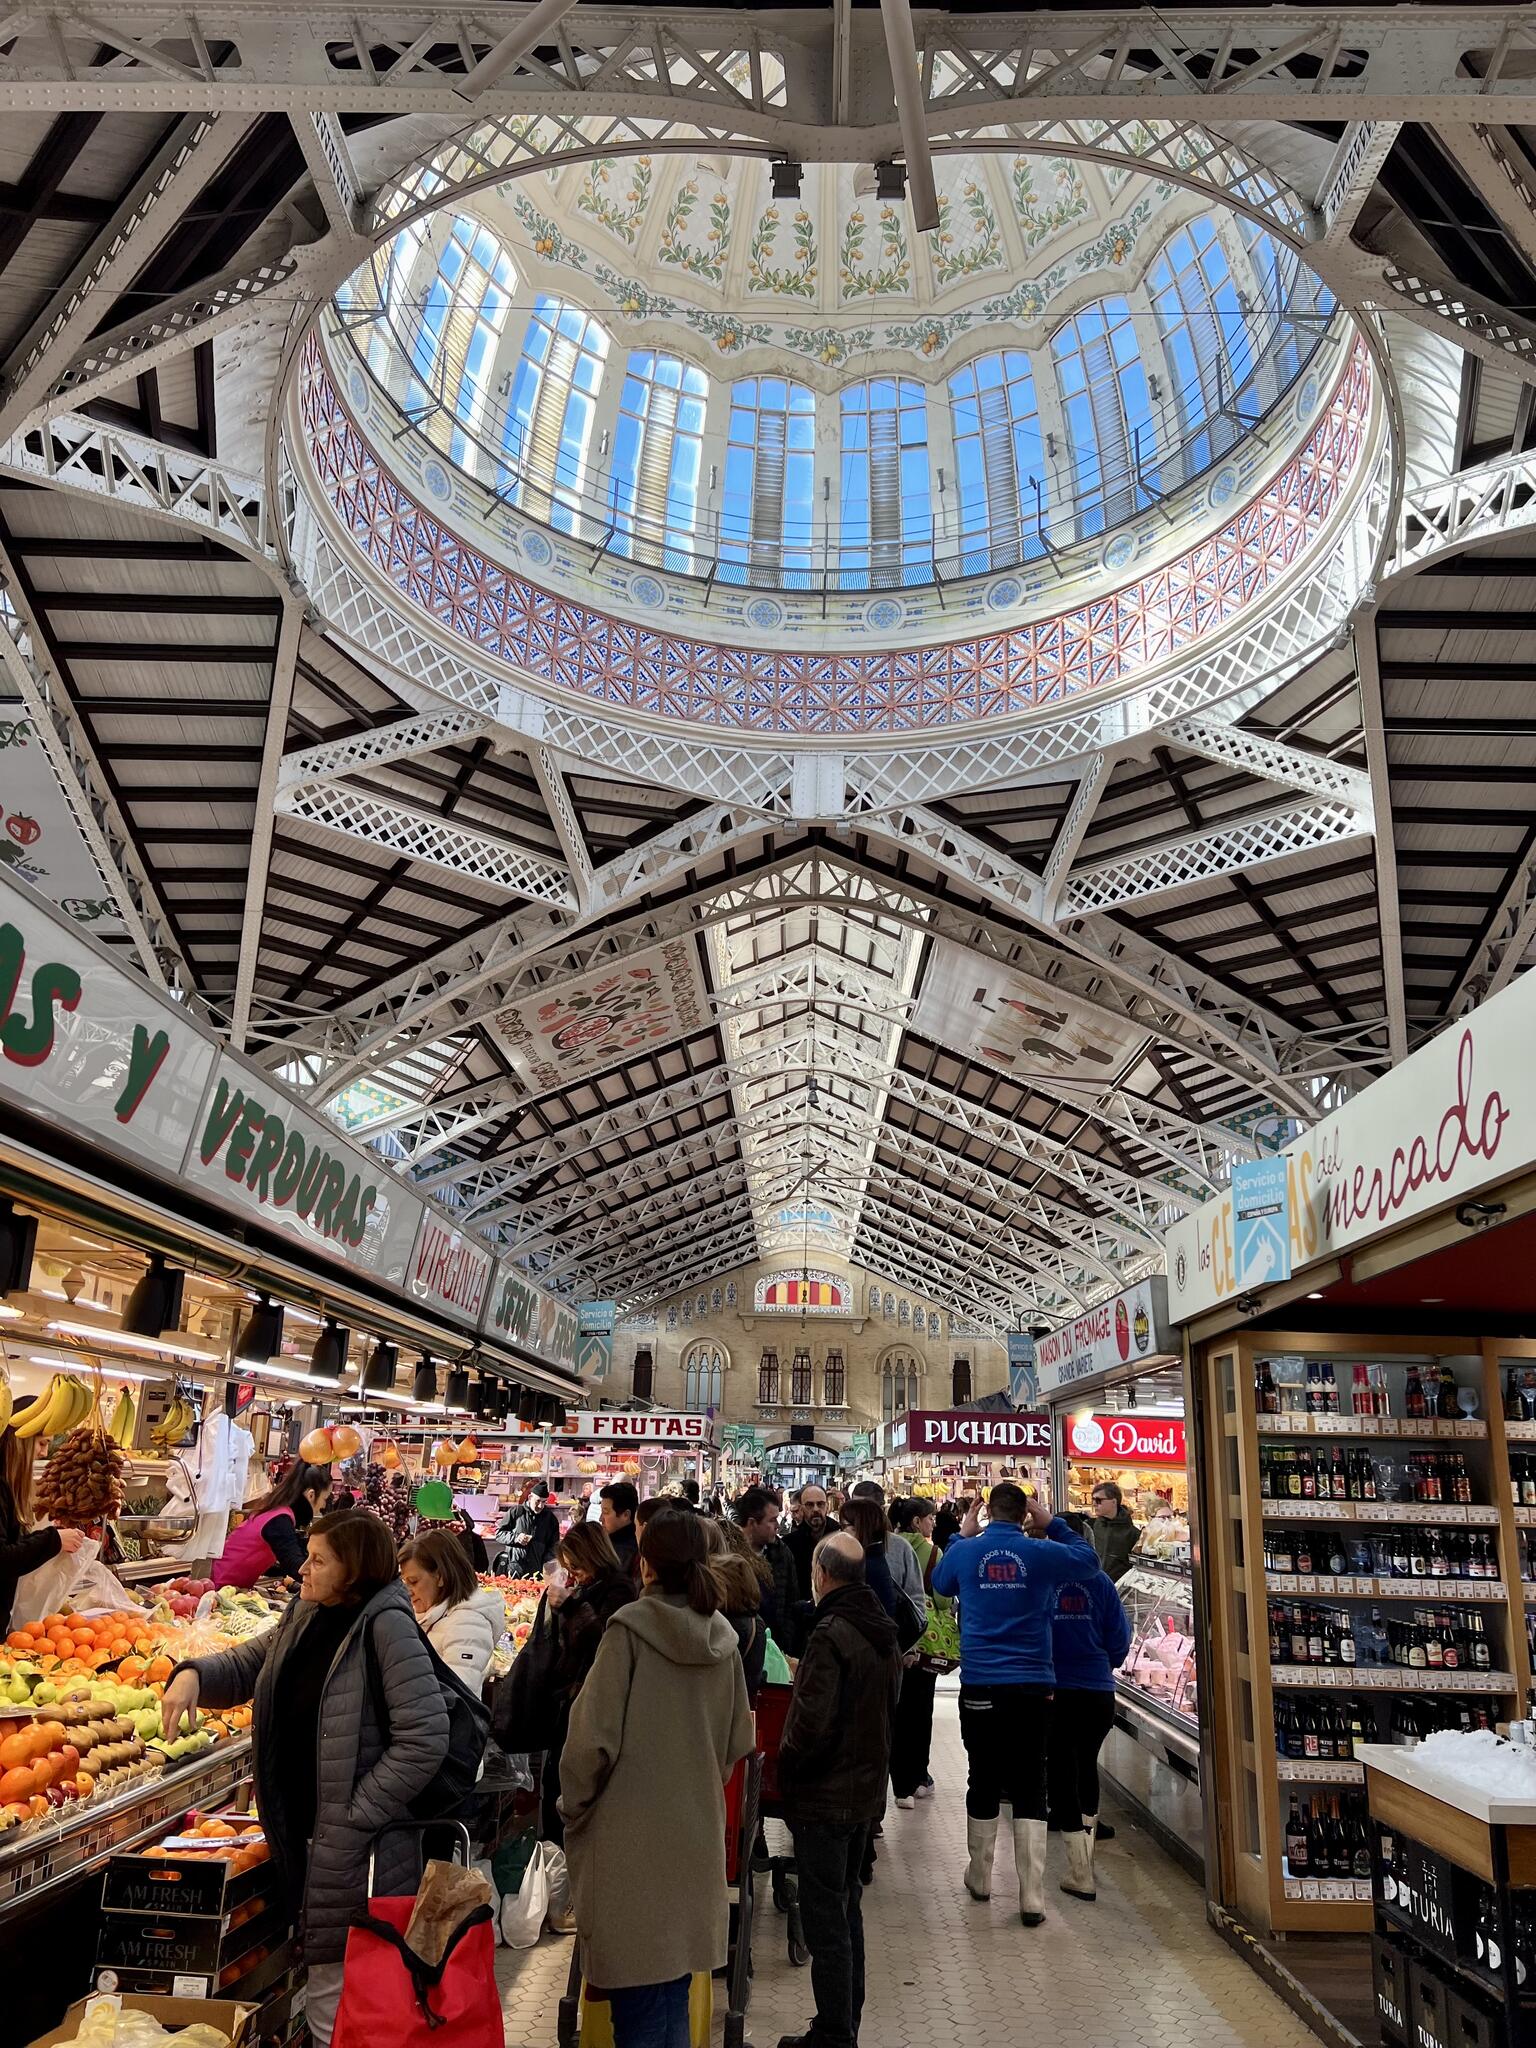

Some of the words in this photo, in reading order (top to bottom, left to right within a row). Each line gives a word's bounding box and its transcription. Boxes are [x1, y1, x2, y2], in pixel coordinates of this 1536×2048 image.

[114, 1023, 170, 1124] Y
[200, 1077, 377, 1248] VERDURAS
[1322, 1028, 1510, 1240] mercado
[1316, 1125, 1343, 1184] del
[1235, 1170, 1276, 1192] Servicio
[1278, 1171, 1285, 1184] a
[1238, 1187, 1285, 1210] domicilio
[1196, 1219, 1211, 1273] las
[416, 1221, 487, 1316] VIRGINIA
[580, 1308, 608, 1320] Servicio
[580, 1319, 613, 1331] domicilio
[1040, 1336, 1061, 1367] MAISON
[1062, 1327, 1072, 1356] DU
[1074, 1308, 1111, 1347] FROMAGE
[1058, 1360, 1075, 1384] GRANDE
[593, 1416, 702, 1437] FRUTAS
[924, 1419, 1050, 1447] PUCHADES
[1109, 1422, 1177, 1455] David
[122, 1884, 147, 1899] AM
[151, 1887, 202, 1903] FRESH
[117, 1940, 142, 1956] AM
[145, 1943, 197, 1960] FRESH
[146, 1959, 177, 1968] SPAIN
[1377, 1993, 1403, 2028] TURIA
[1417, 2024, 1443, 2048] TUR
